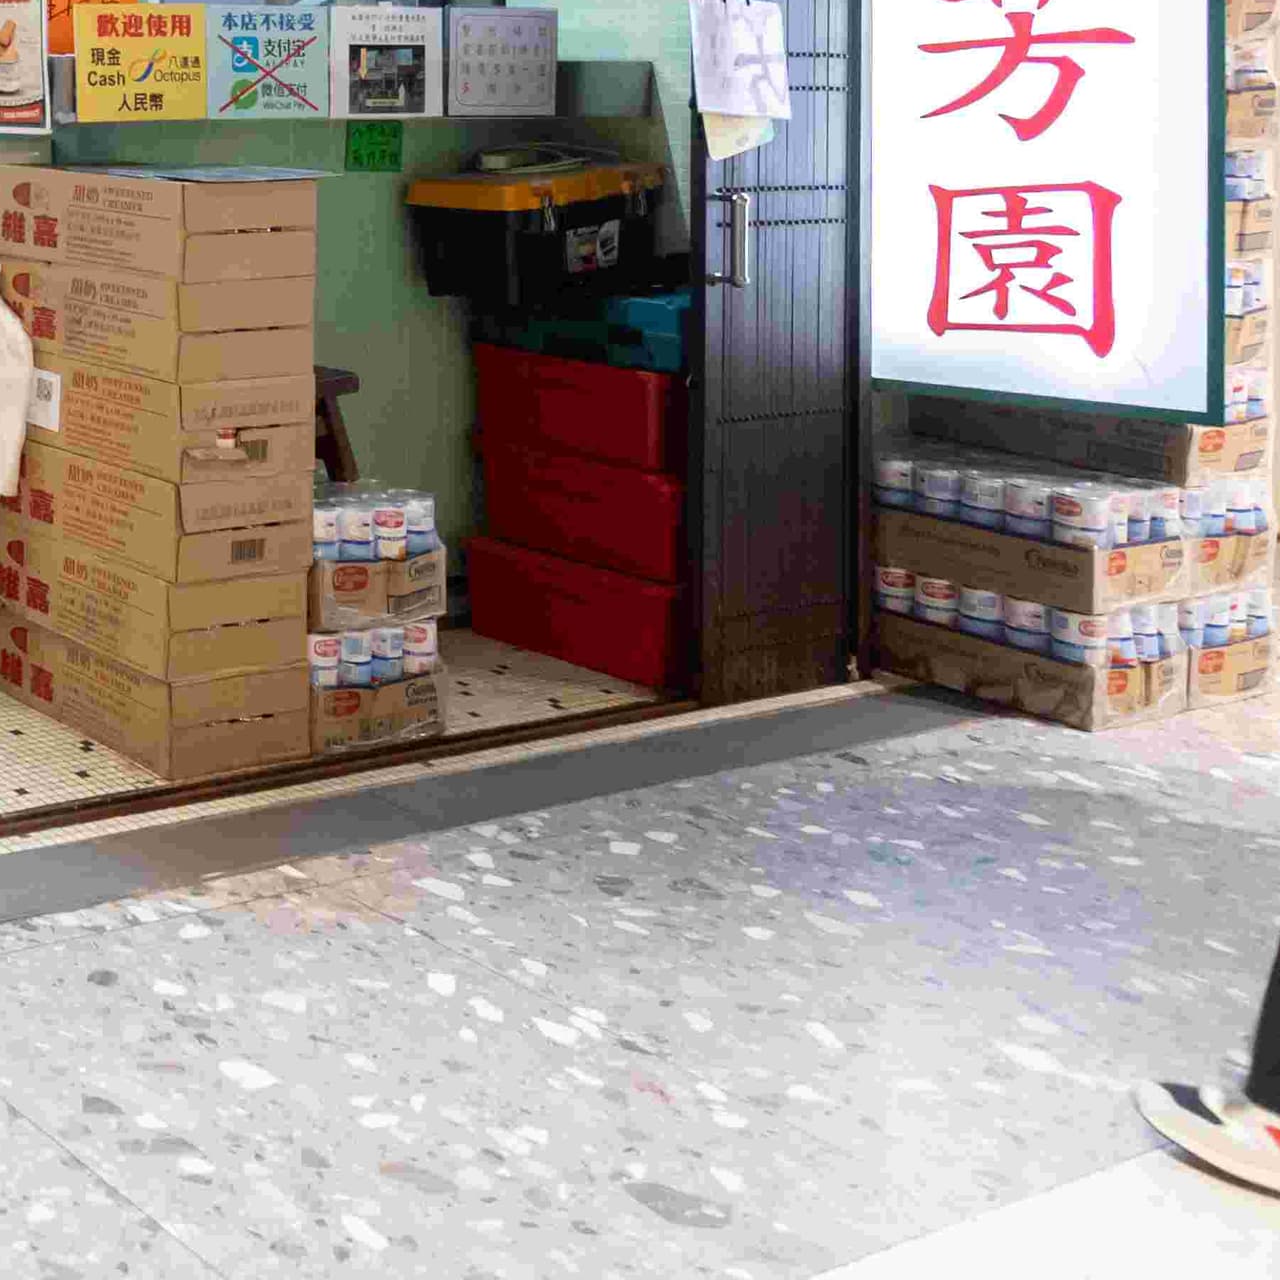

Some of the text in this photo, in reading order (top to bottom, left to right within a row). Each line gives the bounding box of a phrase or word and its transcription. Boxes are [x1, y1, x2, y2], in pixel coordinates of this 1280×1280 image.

[97, 13, 192, 38] 歡迎使用
[222, 12, 316, 32] 本店不接受
[91, 48, 121, 66] 現金
[87, 70, 126, 87] Cash
[154, 69, 201, 85] Octopus
[118, 92, 164, 112] 人民幣
